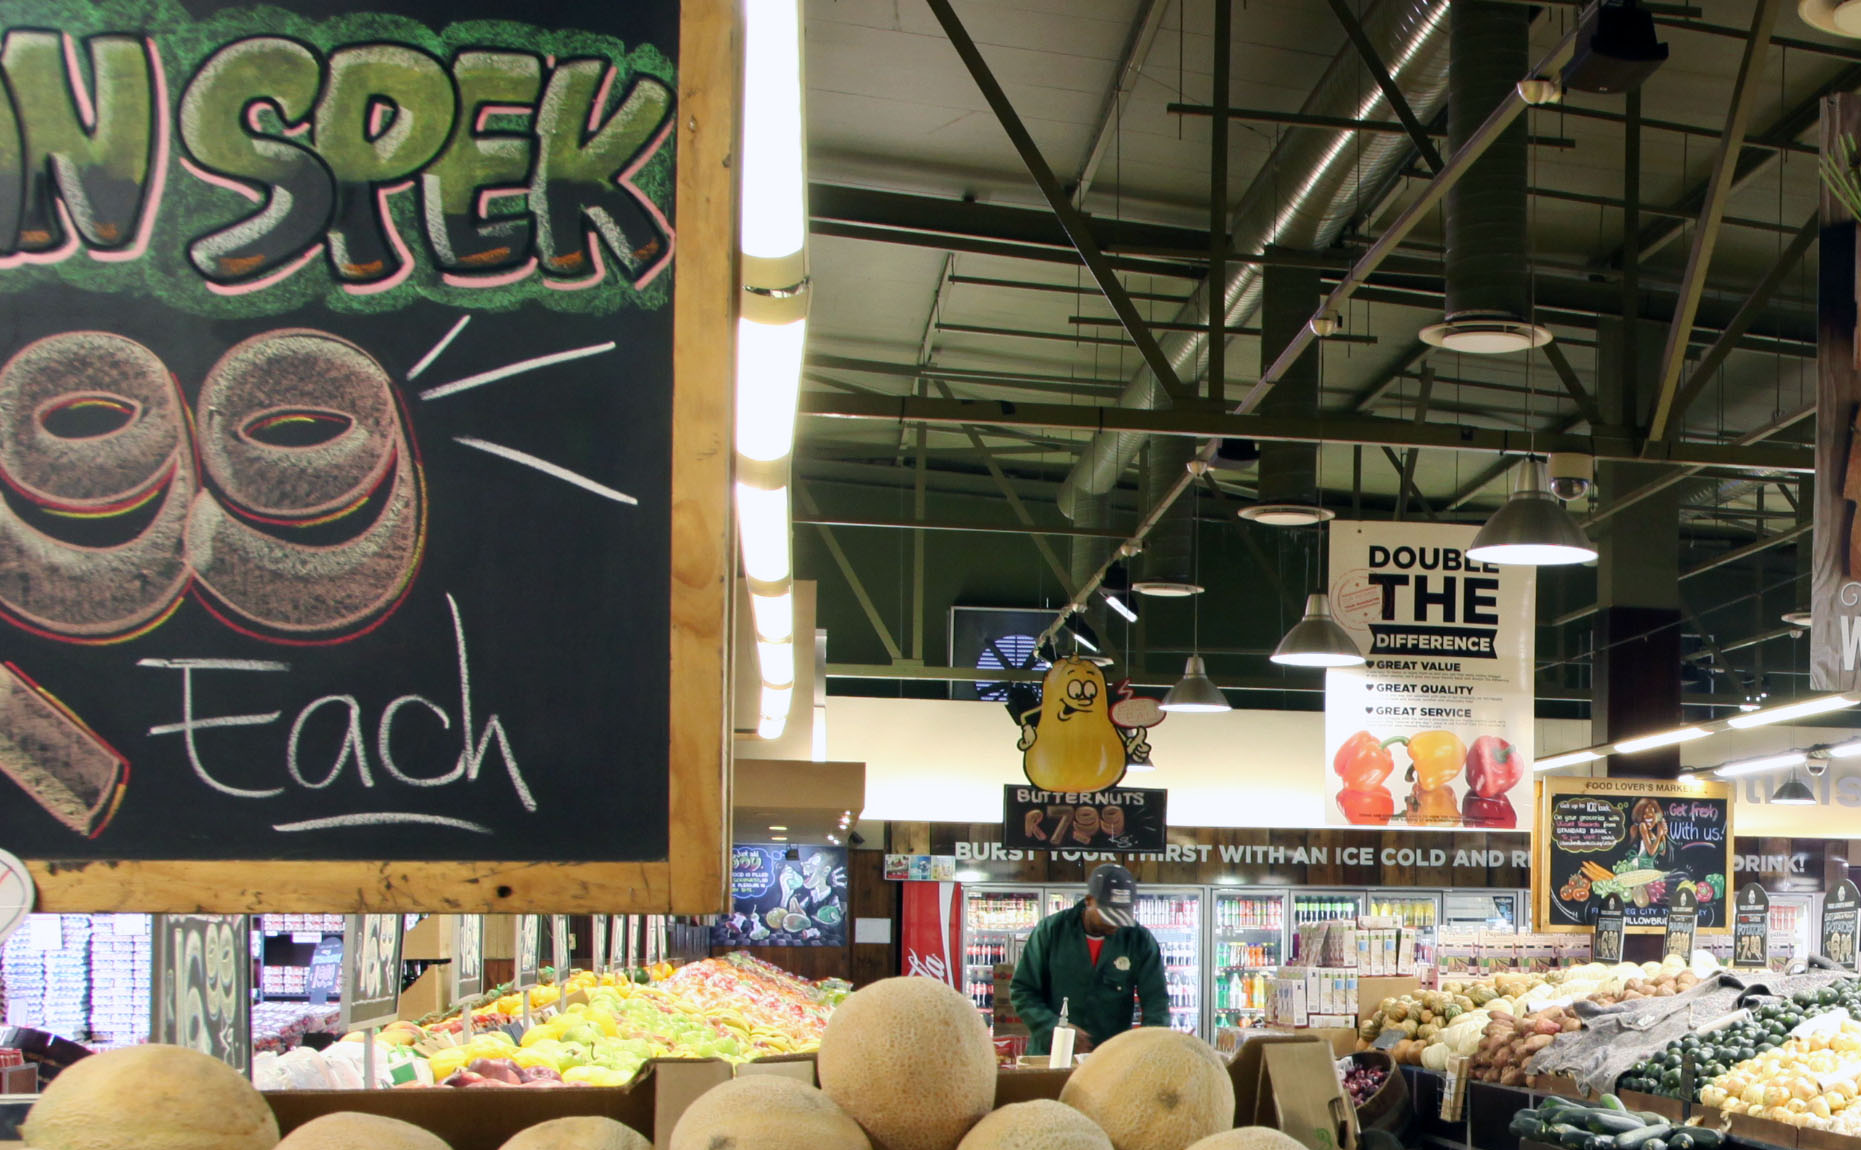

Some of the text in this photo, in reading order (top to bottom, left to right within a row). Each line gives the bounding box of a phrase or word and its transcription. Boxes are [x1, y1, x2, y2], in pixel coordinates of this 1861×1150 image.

[0, 28, 676, 294] N SPEK
[1368, 573, 1498, 625] THE
[1376, 633, 1491, 652] DIFFERENCE
[1376, 660, 1461, 672] GREAT VALUE
[1376, 683, 1474, 695] GREAT QUALITY
[137, 592, 537, 812] Each
[1376, 706, 1472, 717] GREAT SERVICE
[1586, 781, 1613, 790] FOOD
[1615, 782, 1653, 791] LOVER'S
[1017, 788, 1144, 805] BUTTERNUTS
[1669, 801, 1718, 822] Get fresh
[1669, 822, 1699, 841] With
[955, 841, 1035, 861] BURST
[1219, 845, 1284, 865] WITH
[1291, 845, 1328, 865] AN
[1336, 847, 1374, 866] ICE
[1380, 848, 1446, 867] COLD
[1452, 849, 1504, 868] AND
[1733, 854, 1805, 873] DRINK!
